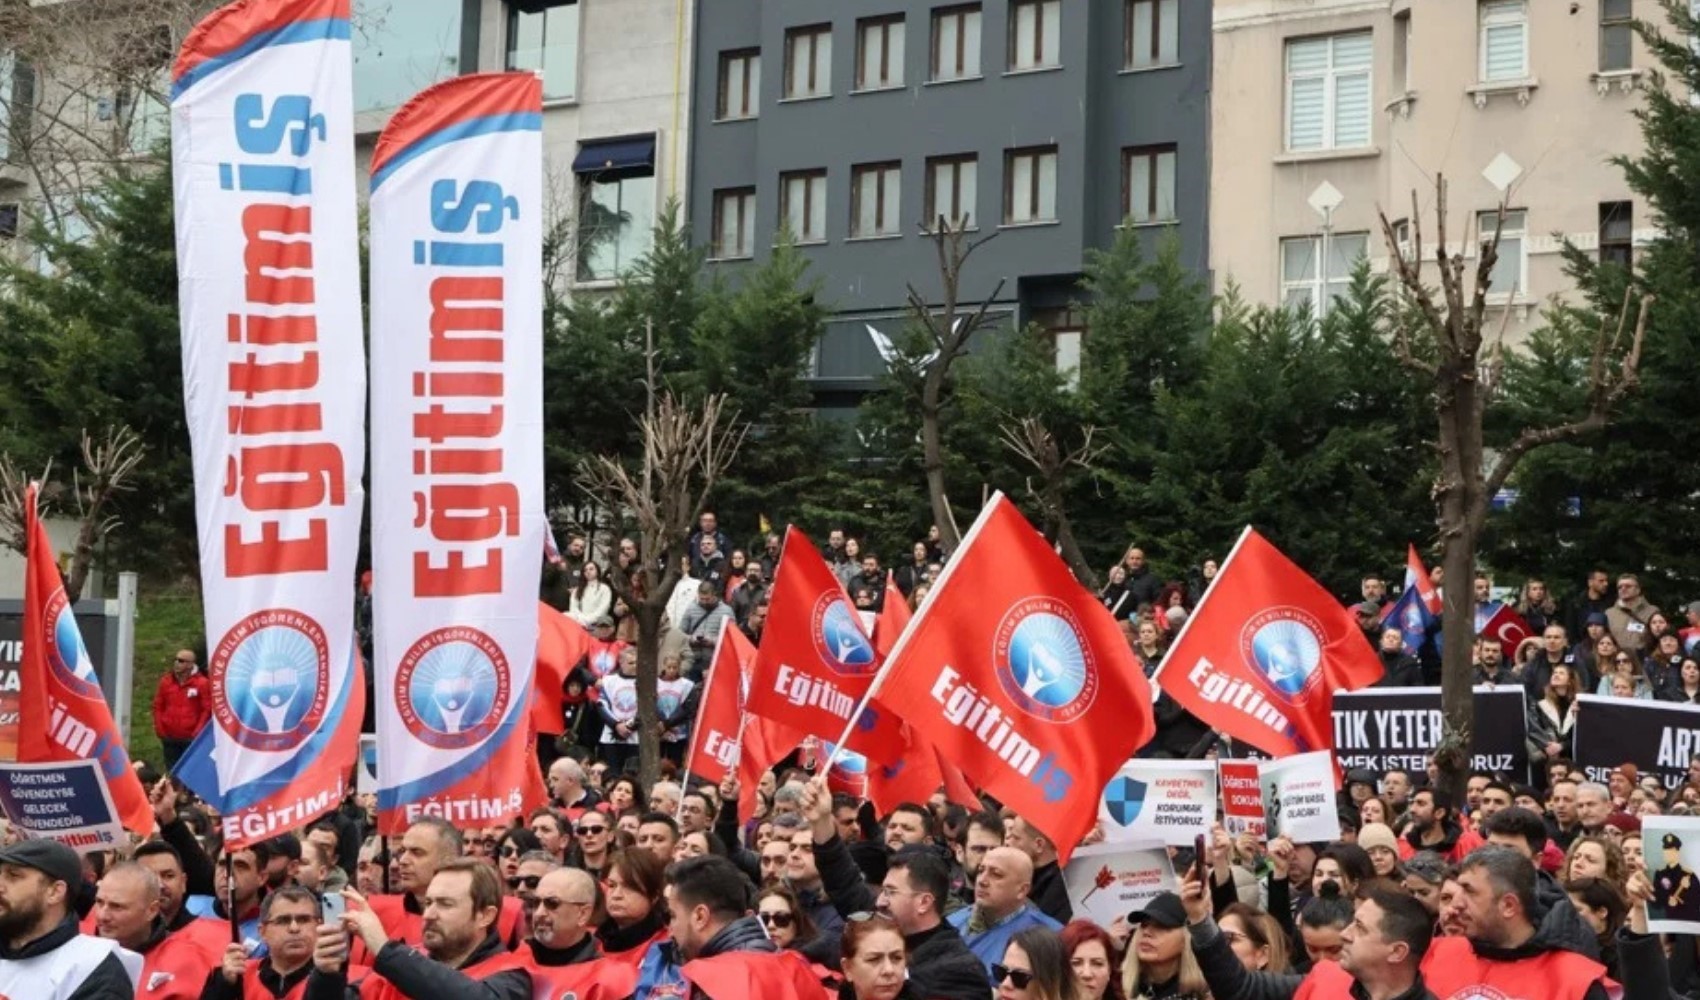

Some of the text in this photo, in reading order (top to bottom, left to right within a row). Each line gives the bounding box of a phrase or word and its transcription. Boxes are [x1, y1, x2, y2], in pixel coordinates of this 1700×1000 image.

[219, 93, 345, 578] Eğitimiş
[413, 178, 520, 598] Eğitimiş
[1156, 803, 1203, 813] KORUMAK
[1331, 711, 1370, 749] TIK
